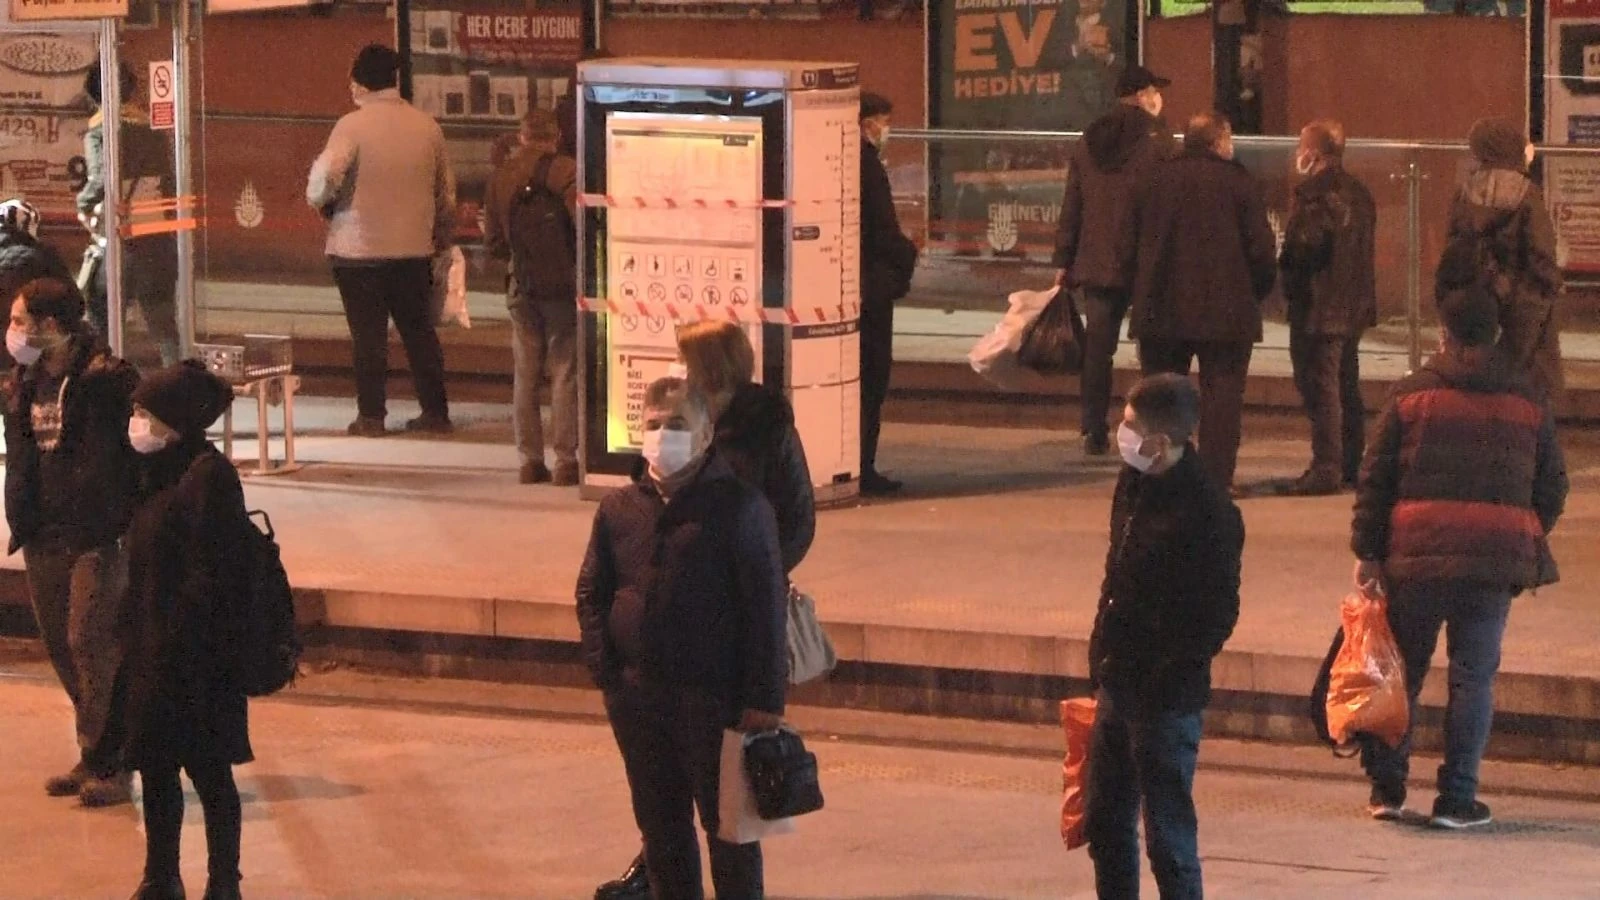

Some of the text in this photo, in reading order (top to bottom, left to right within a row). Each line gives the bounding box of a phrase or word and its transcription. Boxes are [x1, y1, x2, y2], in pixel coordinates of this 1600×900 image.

[467, 15, 580, 39] HER CEBE UYGUN!
[954, 9, 1057, 71] EV
[954, 68, 1062, 98] HEDİYE!
